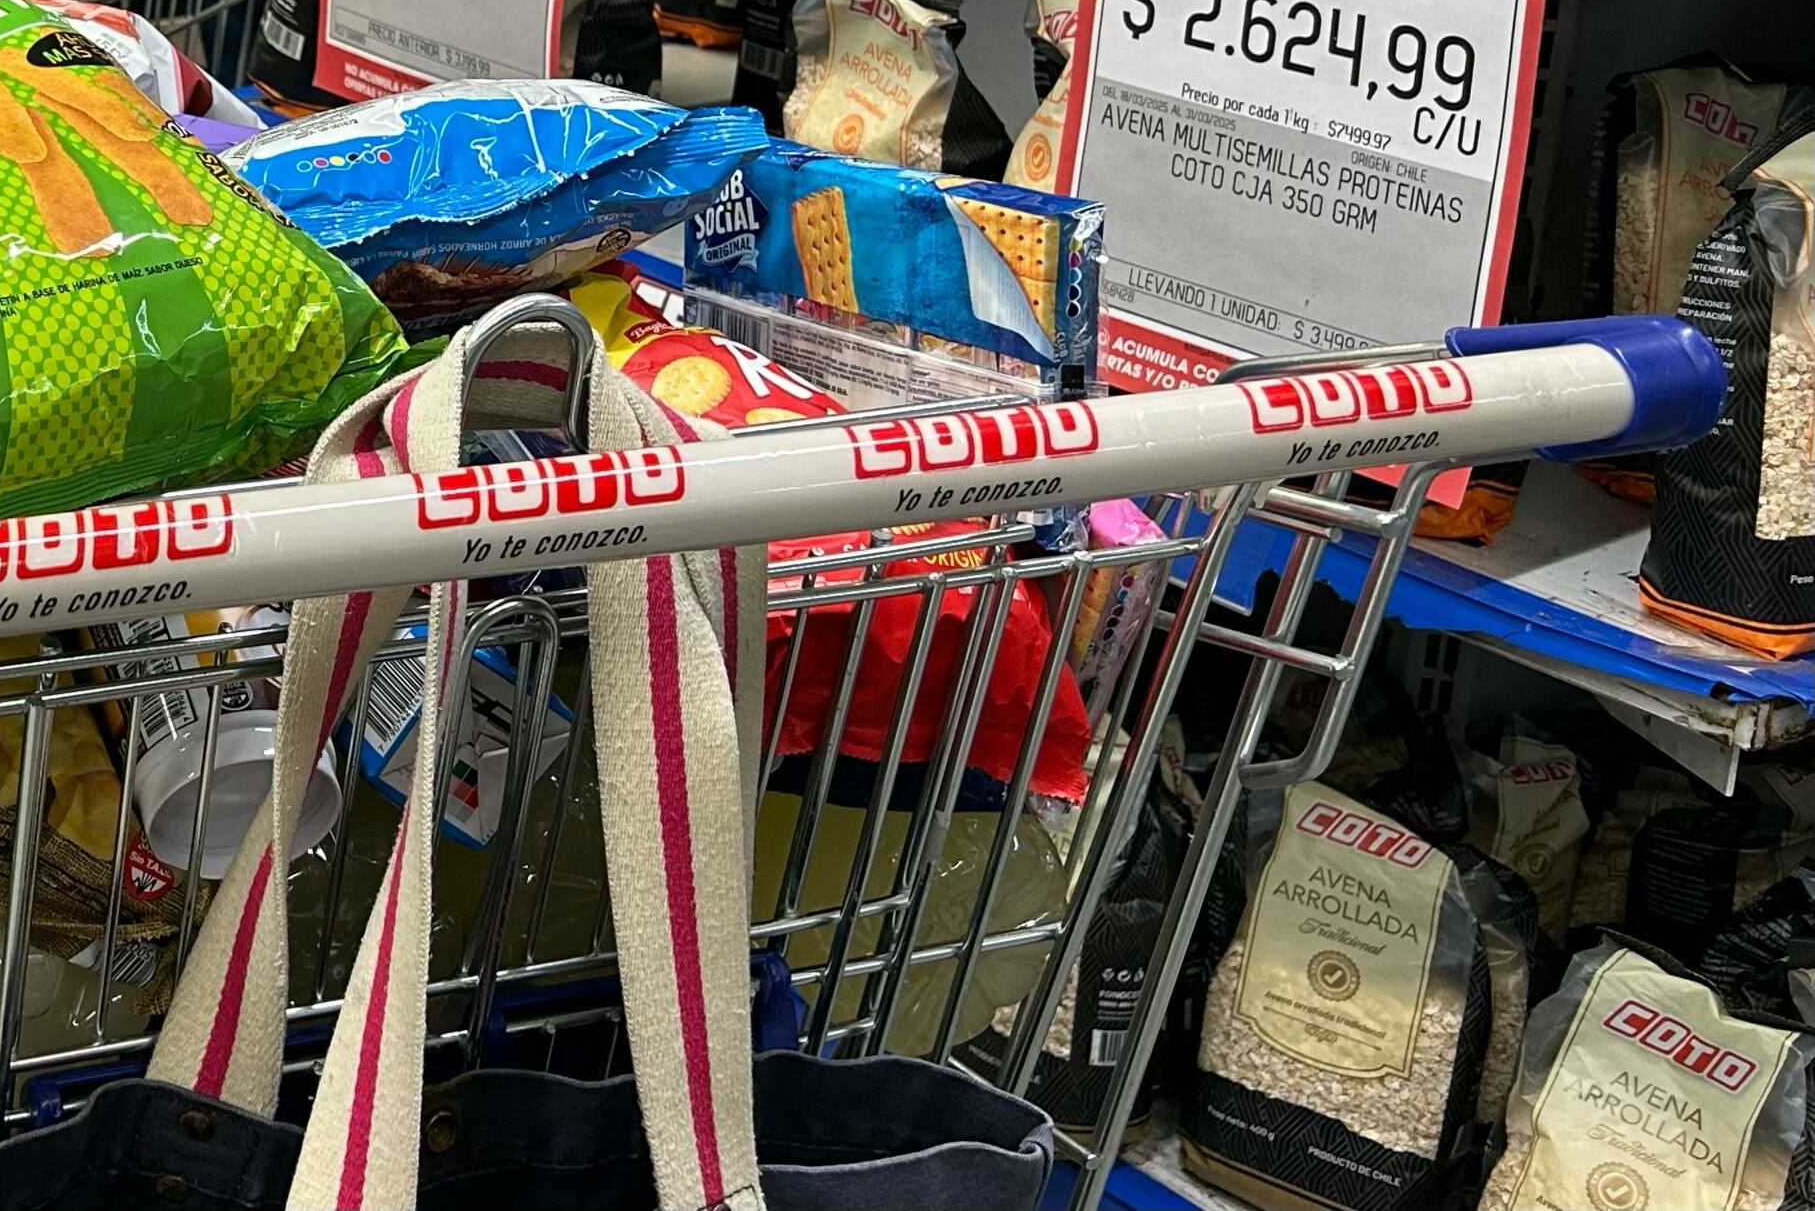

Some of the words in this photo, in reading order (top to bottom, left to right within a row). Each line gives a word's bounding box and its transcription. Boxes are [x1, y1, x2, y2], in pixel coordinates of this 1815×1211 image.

[864, 41, 913, 82] AVENA
[1180, 83, 1220, 107] Precio
[1223, 96, 1246, 115] por
[1248, 103, 1279, 123] cada
[1412, 105, 1482, 158] C/U
[1101, 102, 1166, 142] AVENA
[1172, 121, 1331, 188] MULTISEMILLAS
[1338, 168, 1464, 226] PROTEINAS
[1396, 161, 1429, 184] CHILE
[1170, 153, 1225, 191] COTO
[1231, 170, 1274, 206] CJA
[1281, 185, 1324, 219] 350
[1331, 198, 1378, 235] GRM
[705, 239, 753, 262] ORIGINAL
[32, 285, 57, 301] BASE
[72, 275, 107, 292] HARINA
[144, 261, 174, 278] SABOR
[174, 256, 204, 271] QUESO
[1128, 268, 1205, 309] LLEVANDO
[1220, 294, 1280, 332] UNIDAD:
[1293, 320, 1306, 343] $
[1111, 336, 1189, 374] ACUMULA
[1237, 359, 1473, 434] COTO
[849, 399, 1099, 480] COTO
[1287, 440, 1314, 466] Yo
[1318, 436, 1343, 461] te
[1349, 429, 1441, 458] conozco.
[412, 445, 684, 529] COTO
[894, 488, 925, 515] Yo
[932, 483, 958, 508] te
[961, 474, 1064, 503] conozco.
[461, 539, 491, 565] Yo
[499, 533, 527, 559] te
[537, 523, 649, 555] conozco.
[30, 591, 58, 619] te
[68, 579, 193, 614] conozco.
[1296, 802, 1436, 869] COTO
[1272, 879, 1420, 945] ARROLLADA
[1307, 865, 1392, 910] AVENA
[1298, 916, 1388, 958] Tradicional
[1602, 998, 1759, 1093] COTO
[1610, 1070, 1703, 1131] AVENA
[1563, 1078, 1724, 1175] ARROLLADA
[1586, 1122, 1688, 1179] Tradicional
[1307, 1145, 1356, 1173] PRODUCTO
[1372, 1167, 1402, 1188] CHILE
